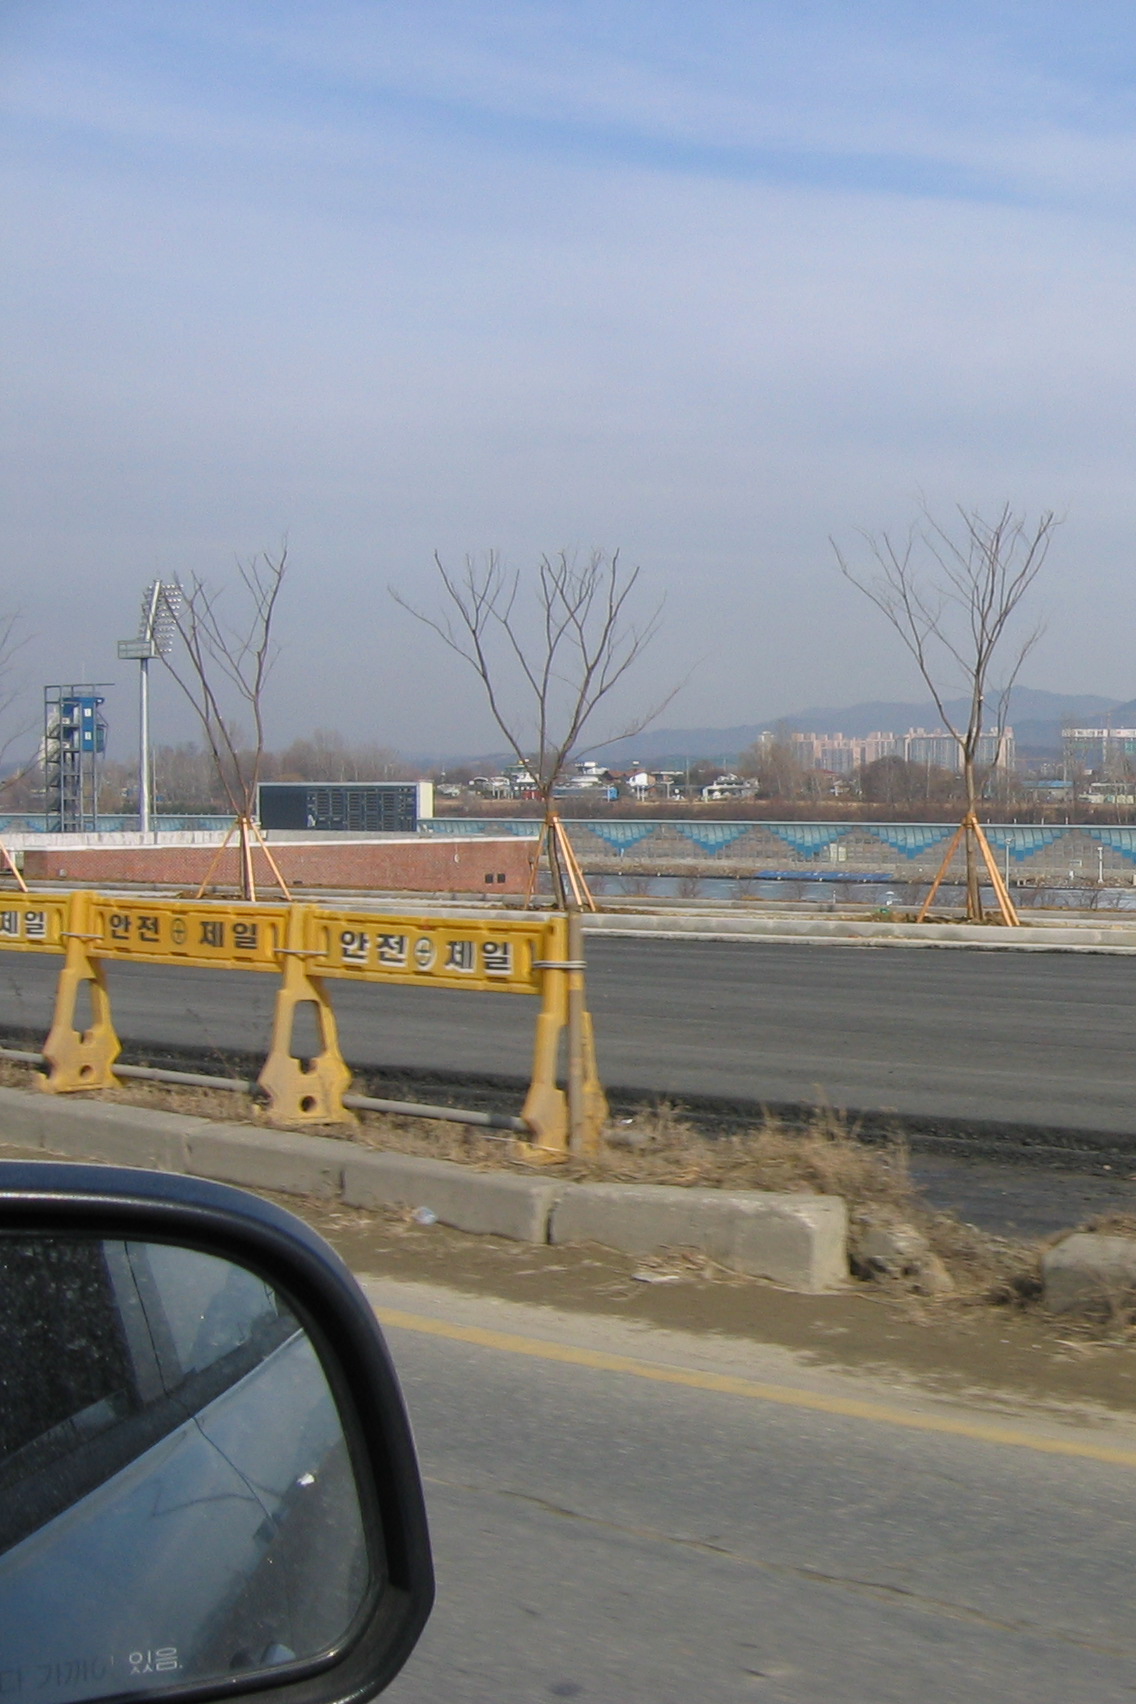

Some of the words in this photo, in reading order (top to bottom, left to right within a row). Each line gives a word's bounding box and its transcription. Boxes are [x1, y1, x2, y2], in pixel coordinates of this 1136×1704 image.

[109, 914, 160, 943] 안전
[198, 921, 258, 950] 제일
[340, 930, 408, 967] 안전
[444, 940, 513, 975] 제일
